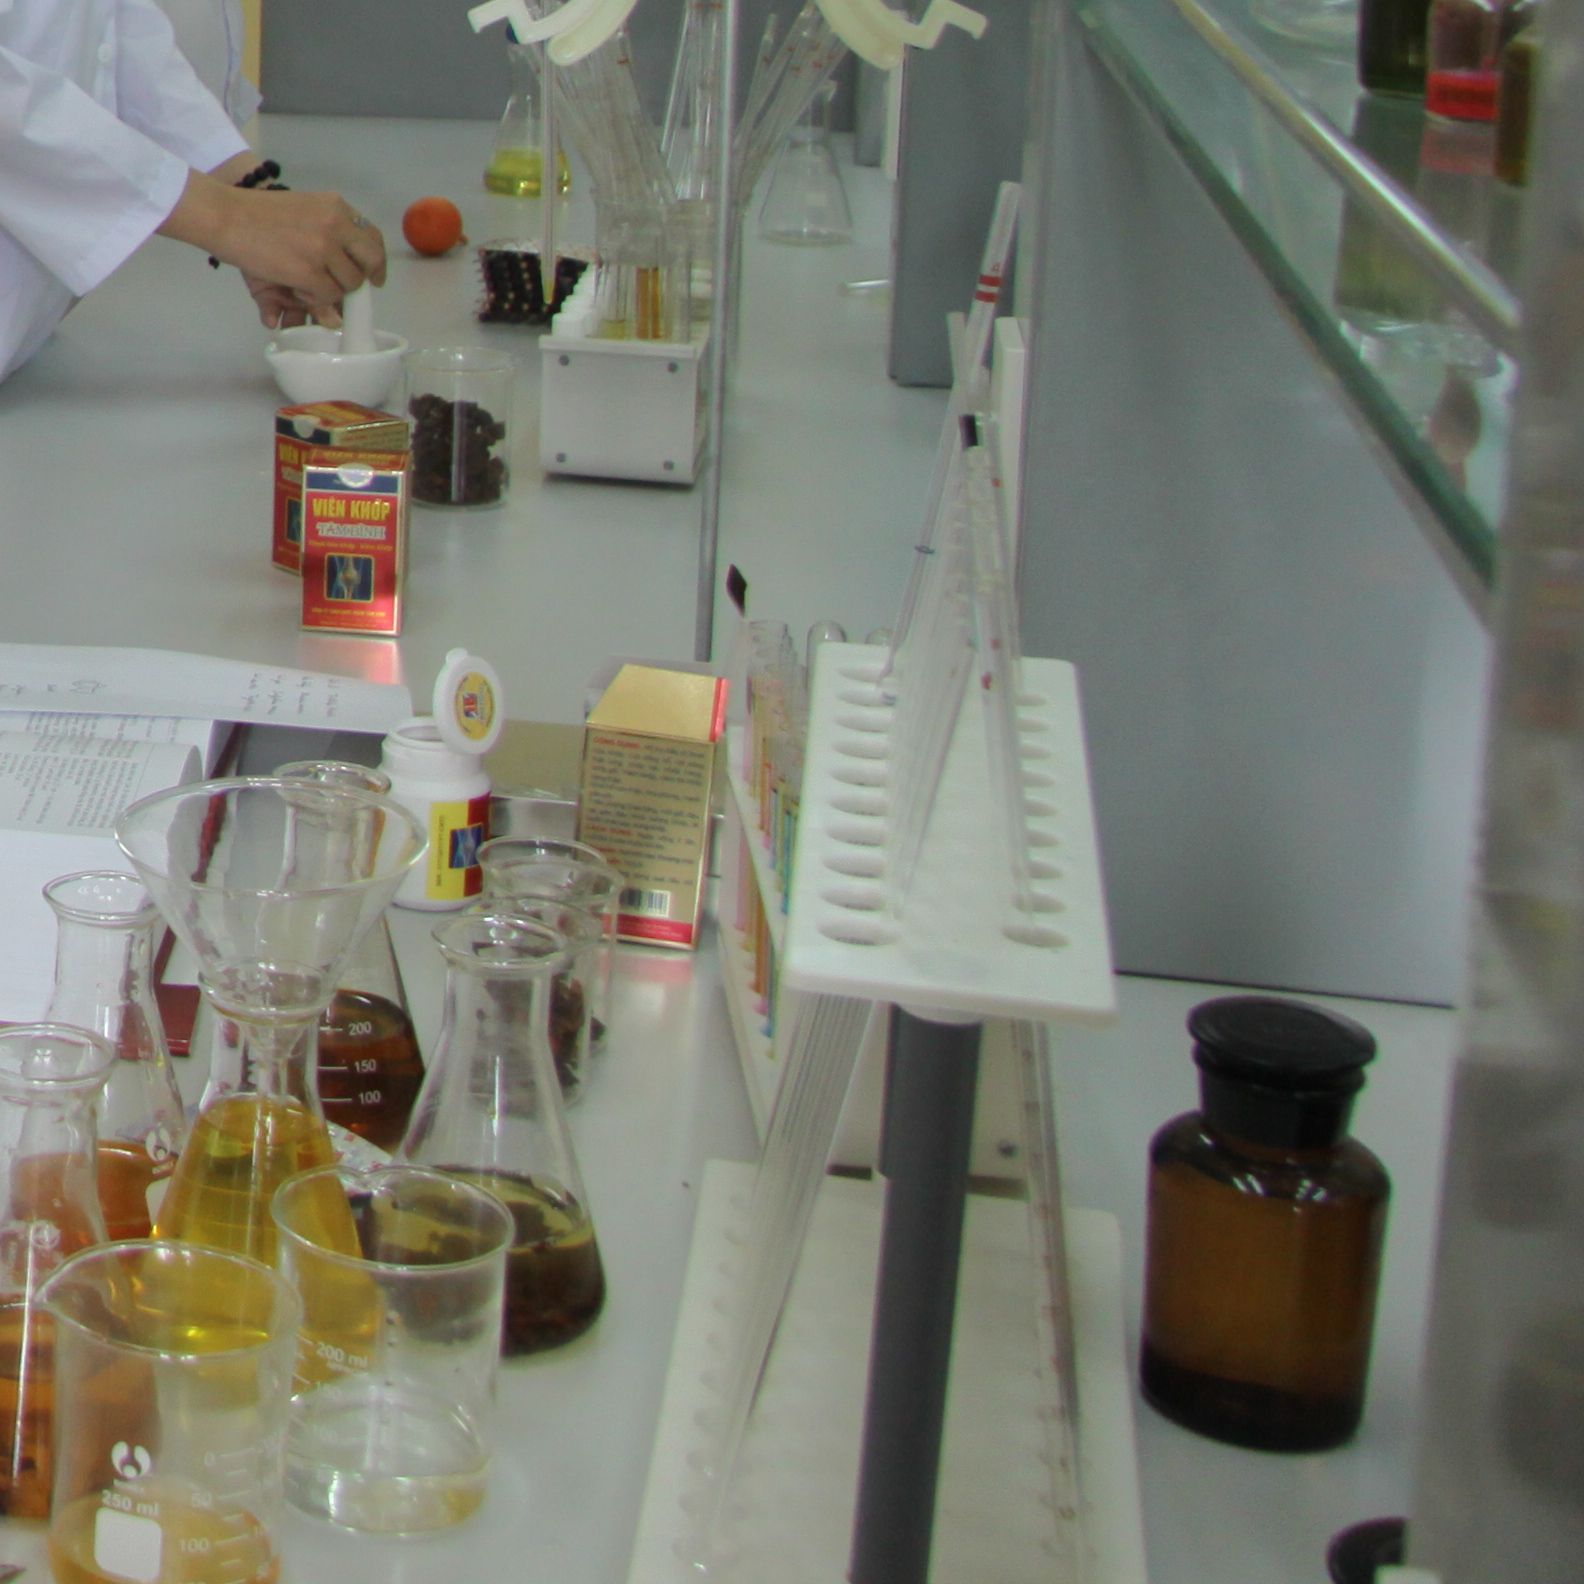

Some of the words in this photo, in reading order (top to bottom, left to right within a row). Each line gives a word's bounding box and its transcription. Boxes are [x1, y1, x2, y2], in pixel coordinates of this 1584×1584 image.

[348, 1021, 373, 1036] 200
[354, 1058, 378, 1073] 150
[358, 1090, 382, 1105] 100
[102, 1488, 132, 1510] 250
[136, 1502, 160, 1516] ml
[180, 1536, 211, 1553] 100
